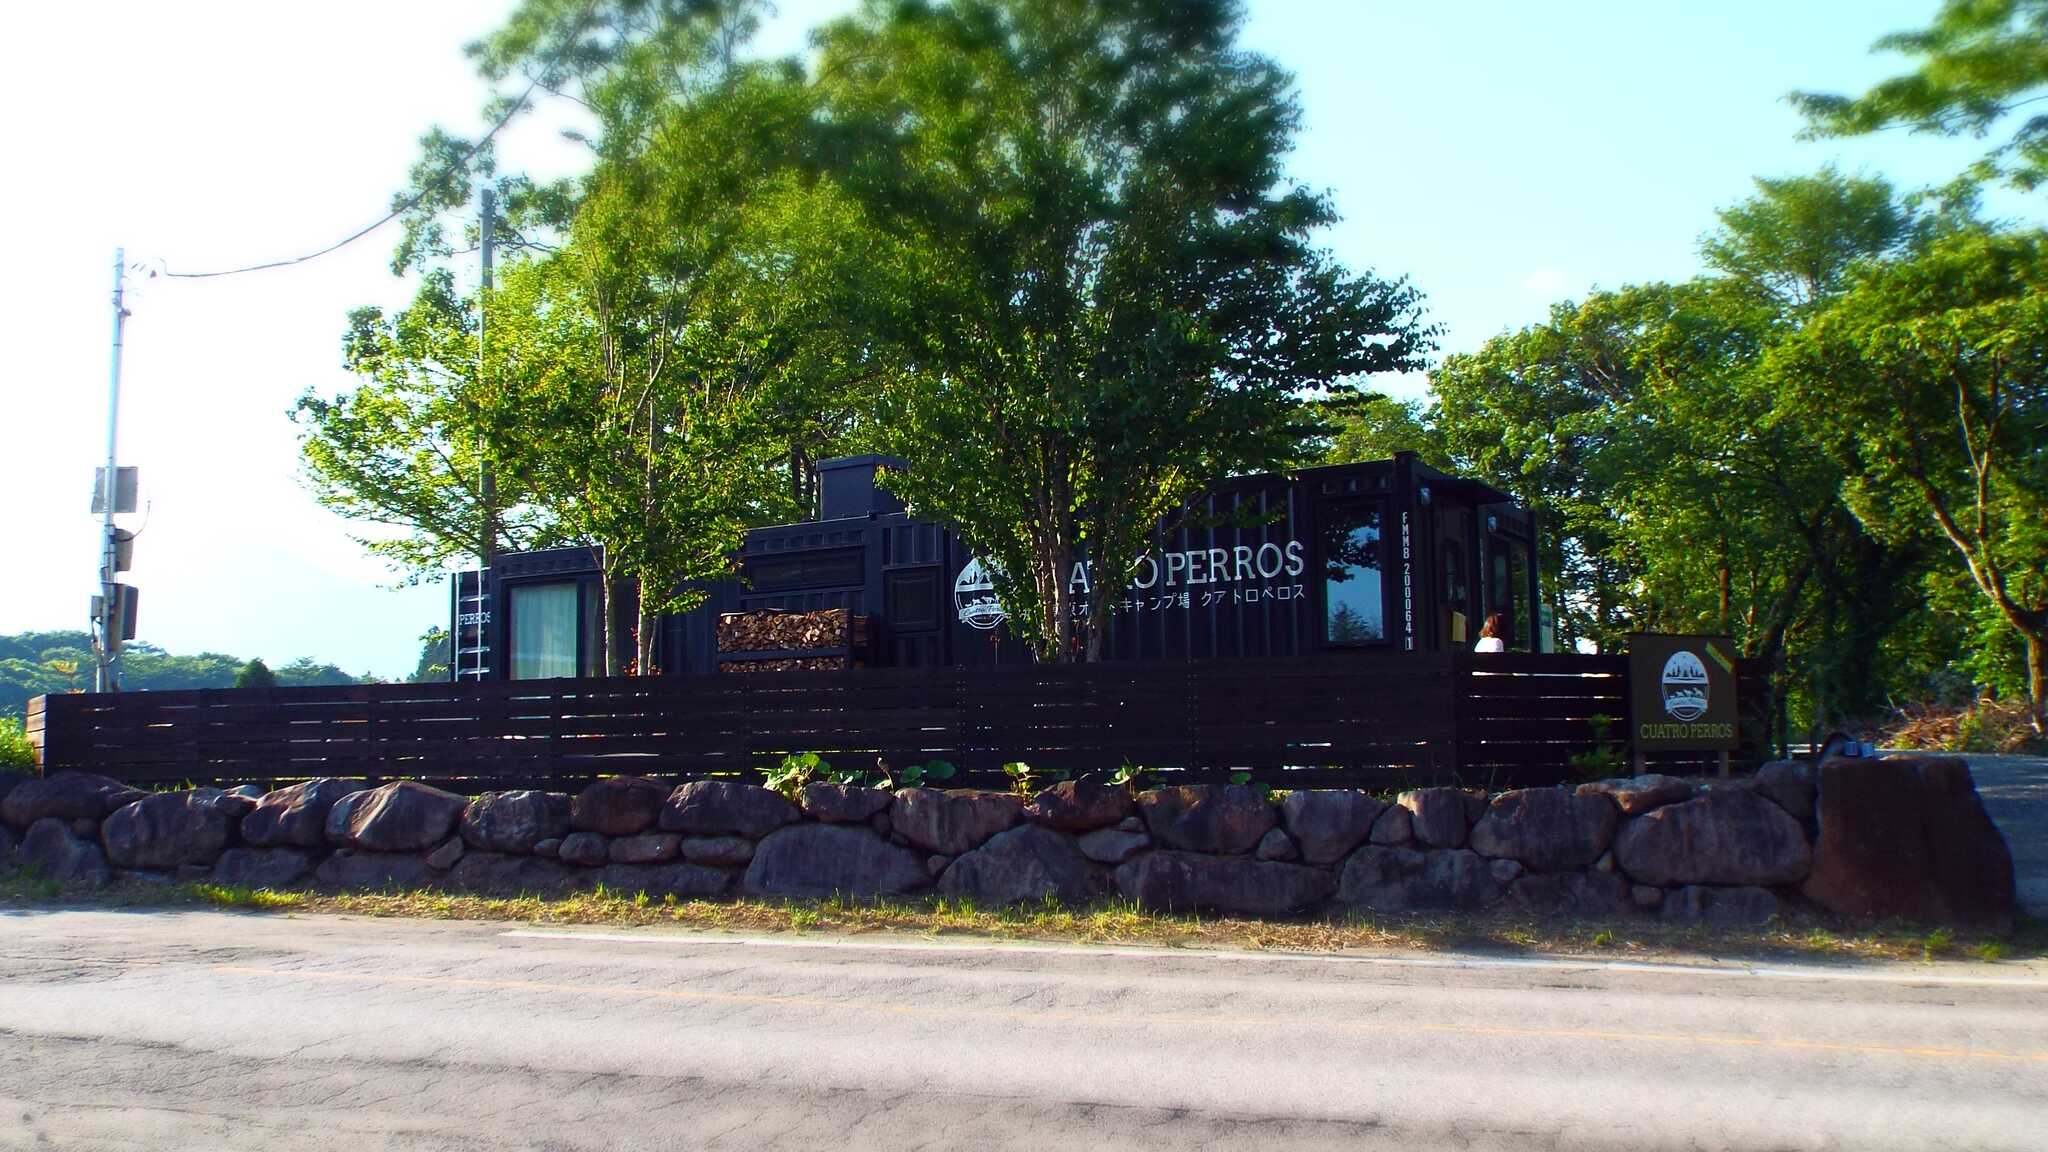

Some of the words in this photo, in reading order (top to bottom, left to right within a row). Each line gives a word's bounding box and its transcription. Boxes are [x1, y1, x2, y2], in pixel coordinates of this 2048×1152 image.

[1165, 540, 1304, 587] PERROS
[1640, 723, 1688, 739] CUATRO
[1689, 723, 1733, 739] PERROS
